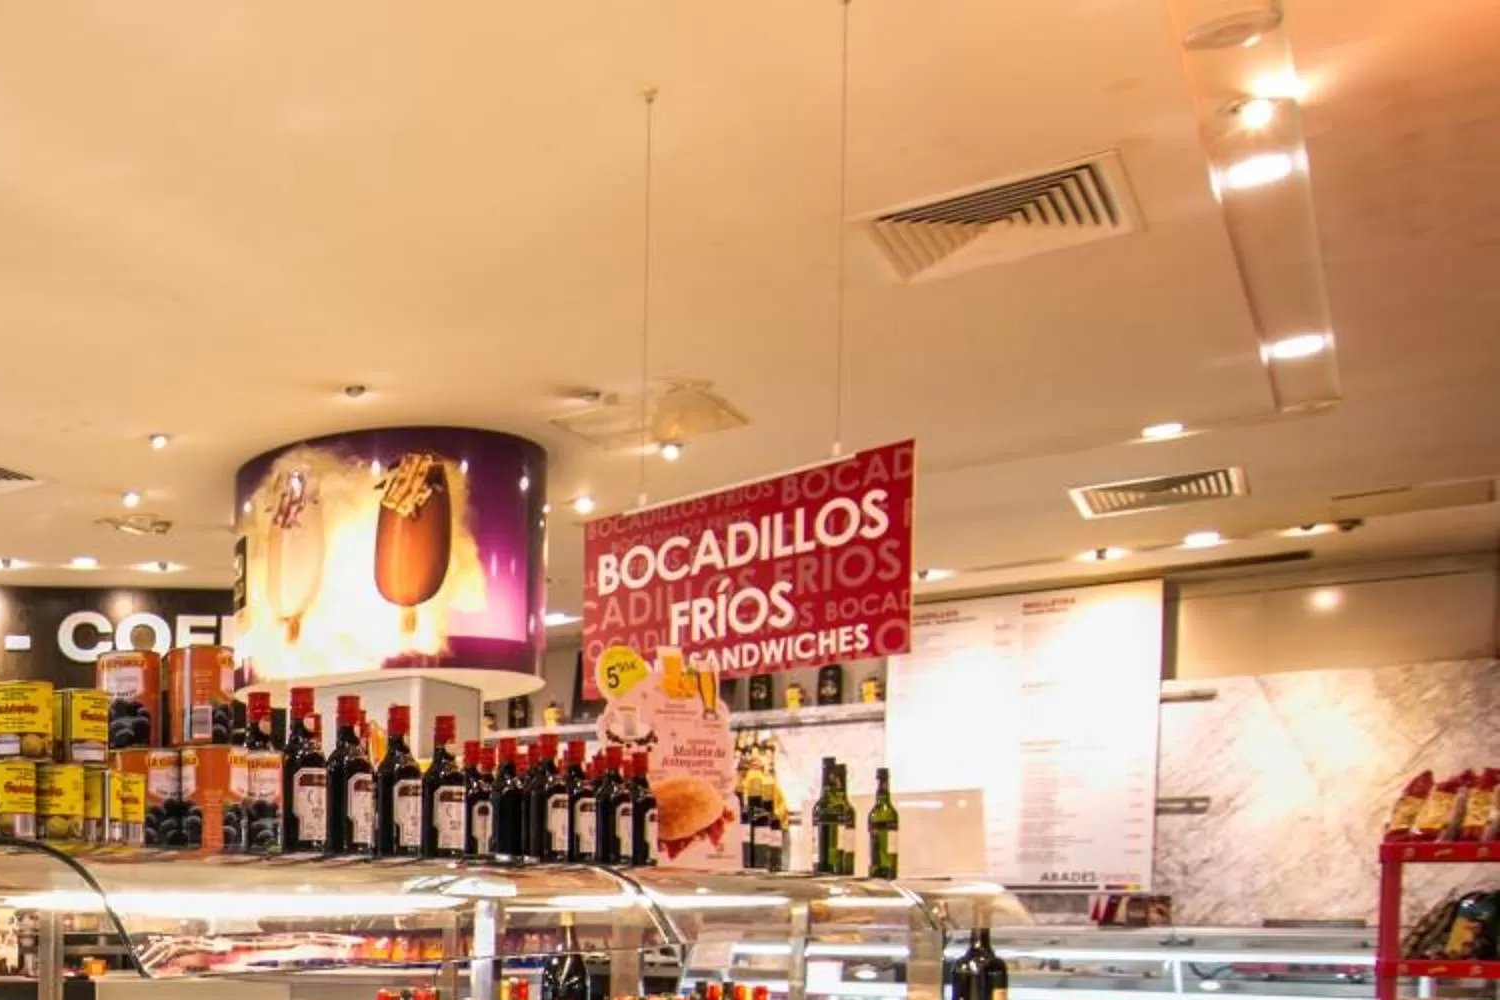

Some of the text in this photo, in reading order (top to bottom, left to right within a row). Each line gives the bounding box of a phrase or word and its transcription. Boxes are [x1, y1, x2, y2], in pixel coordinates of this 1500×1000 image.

[597, 488, 889, 597] BOCADILLOS
[57, 610, 235, 663] COF
[669, 578, 794, 645] FRÍOS
[689, 623, 869, 671] SANDWICHES
